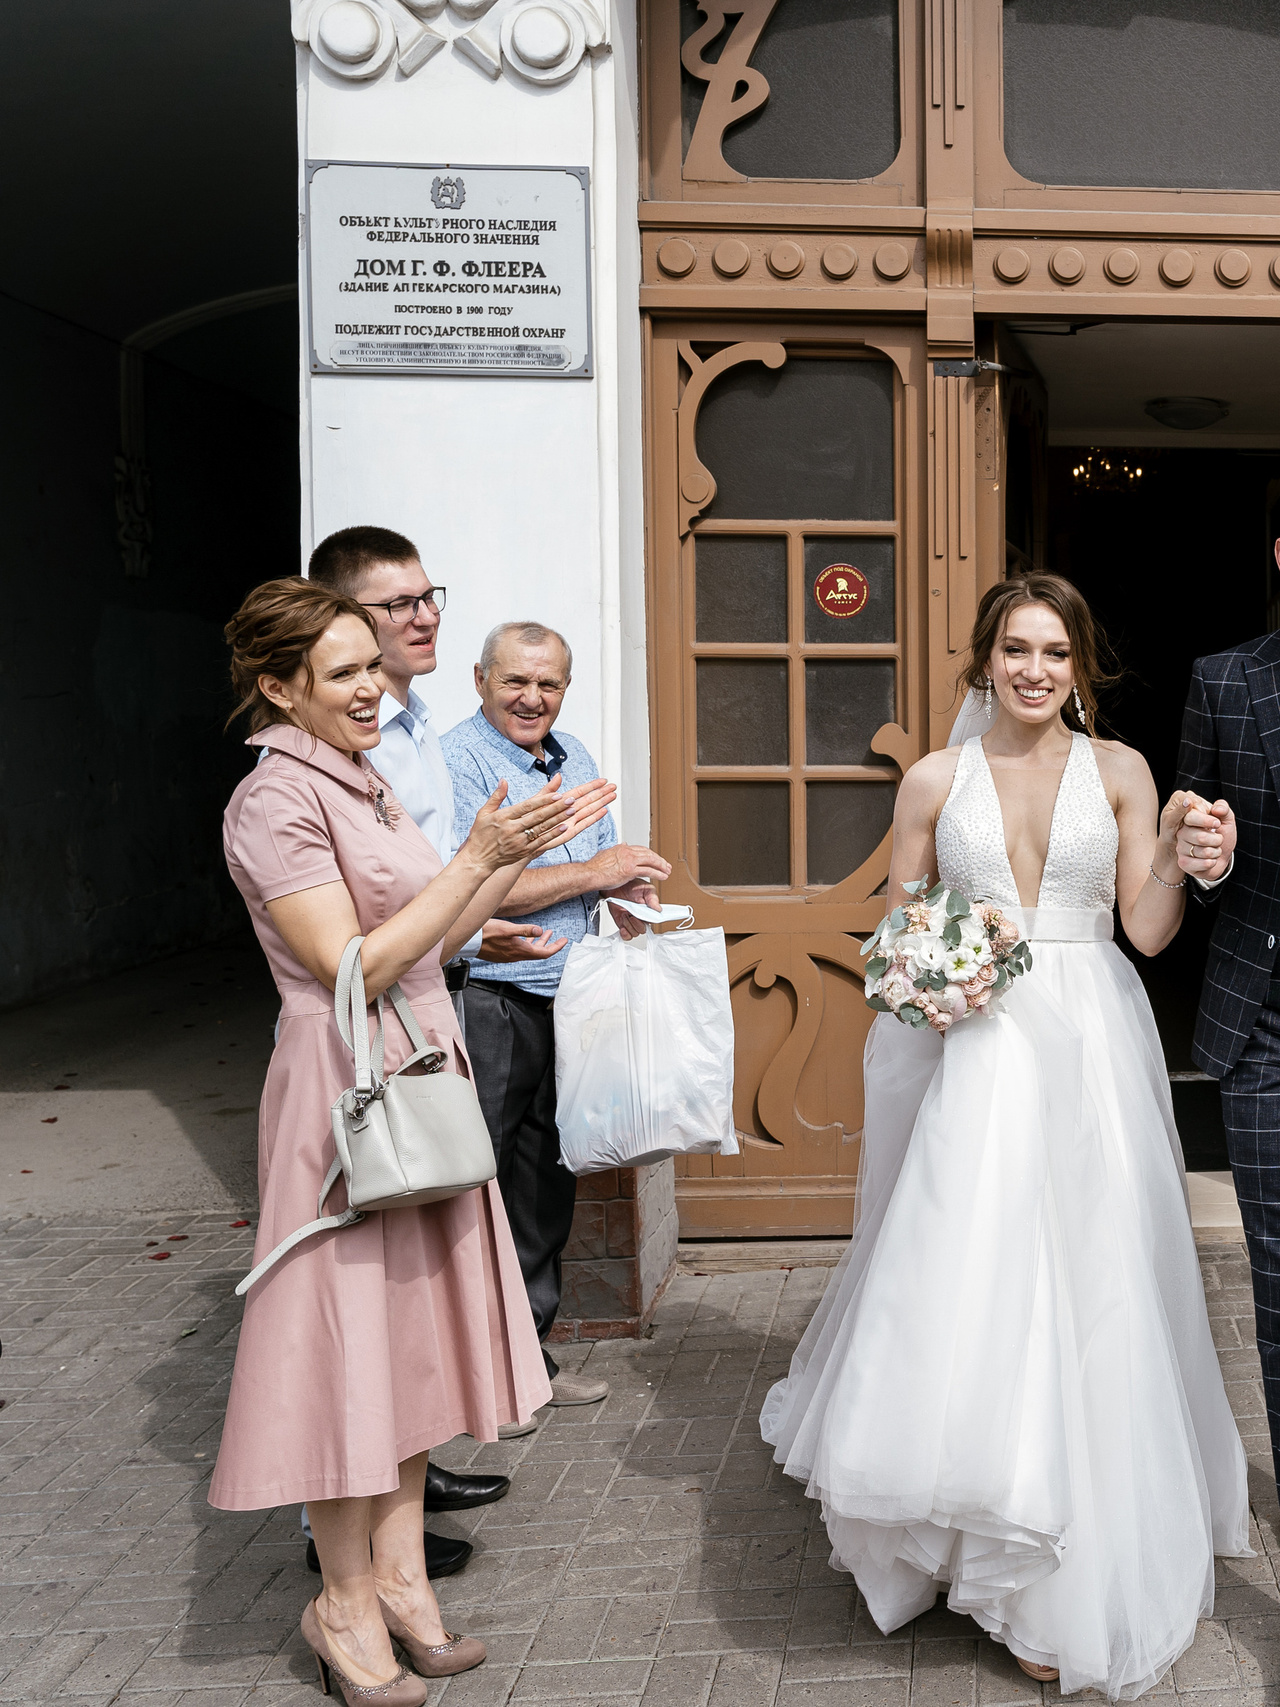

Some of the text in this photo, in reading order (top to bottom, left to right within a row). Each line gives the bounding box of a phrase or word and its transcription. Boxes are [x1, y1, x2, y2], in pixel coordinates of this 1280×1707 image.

[339, 215, 391, 227] ОБЪЕКТ
[488, 219, 557, 233] НАСЛЕДИЯ
[366, 231, 540, 245] ФЕДЕРАЛЬНОГО ЗНАЧЕНИЯ
[354, 259, 546, 278] ДОМ Г. Ф. ФЛЕЕРА
[339, 282, 389, 292] (ЗДАНИЕ
[493, 283, 561, 296] МАГАЗИНА)
[394, 305, 513, 316] ПОСТРОЕНО В 1900 ГОДУ
[335, 324, 401, 336] ПОДЛЕЖИТ
[404, 325, 519, 338] ГОСУДАРСТВЕННОЙ
